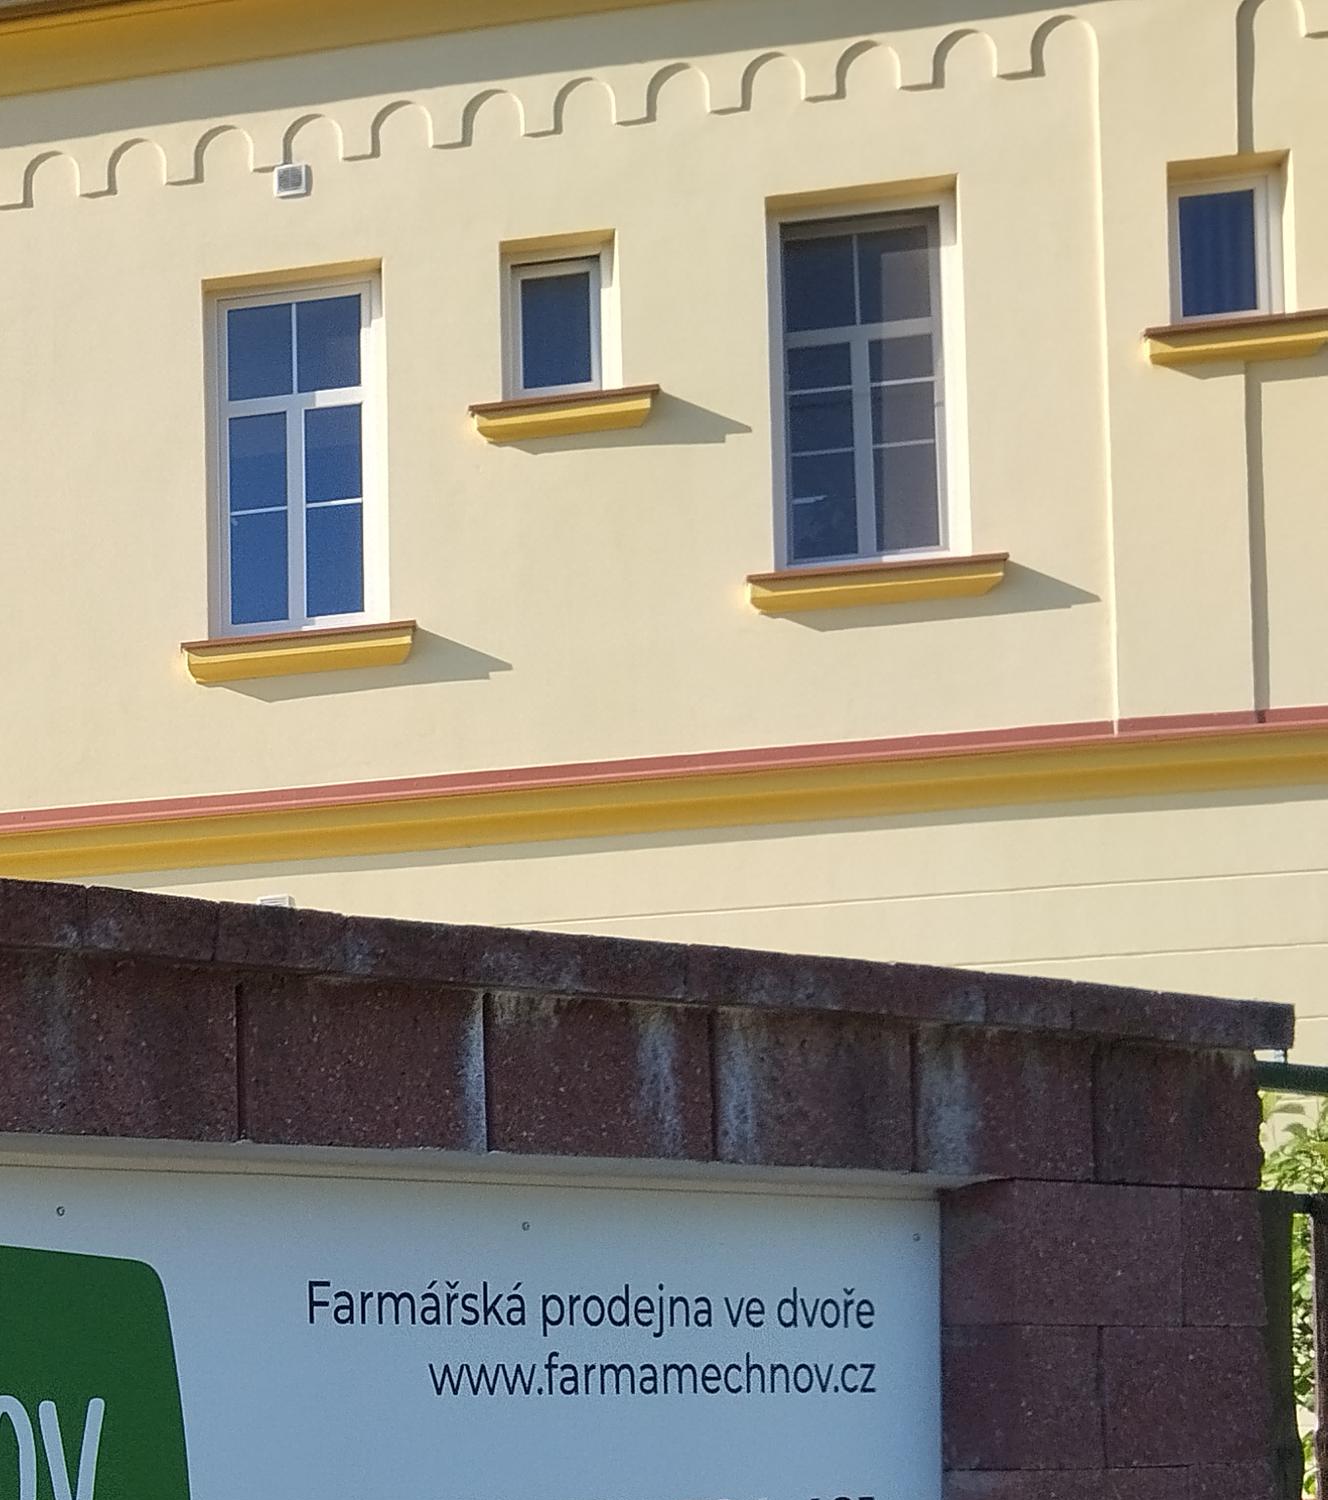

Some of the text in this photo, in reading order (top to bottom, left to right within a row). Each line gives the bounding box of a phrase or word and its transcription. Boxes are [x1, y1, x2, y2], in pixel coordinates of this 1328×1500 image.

[306, 1279, 876, 1338] Farmářská prodejna ve dvoře
[428, 1351, 877, 1397] www.farmamechnov.cz
